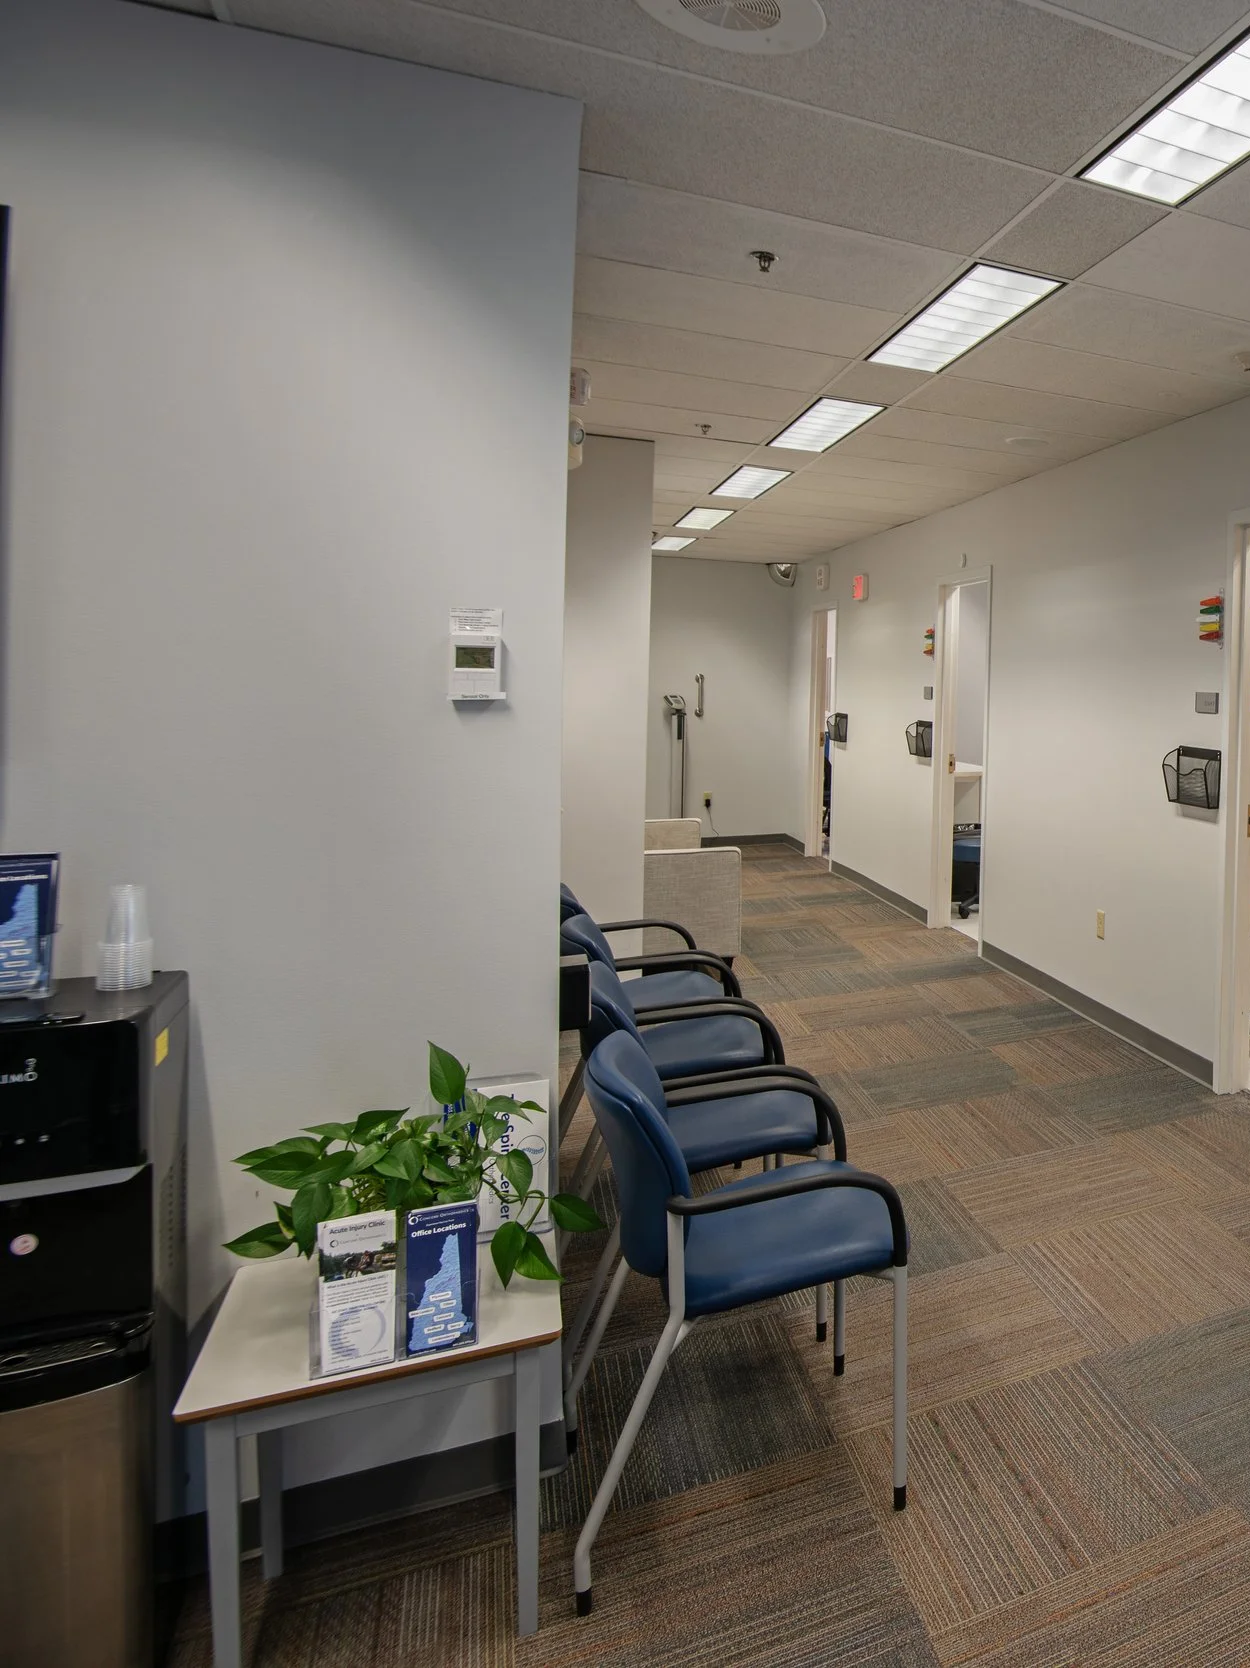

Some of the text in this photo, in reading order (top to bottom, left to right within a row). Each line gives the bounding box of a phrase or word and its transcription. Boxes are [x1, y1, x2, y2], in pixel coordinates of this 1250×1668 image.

[328, 1220, 386, 1235] Acute Injury Clinic
[411, 1229, 432, 1238] Office
[432, 1222, 467, 1234] Locations
